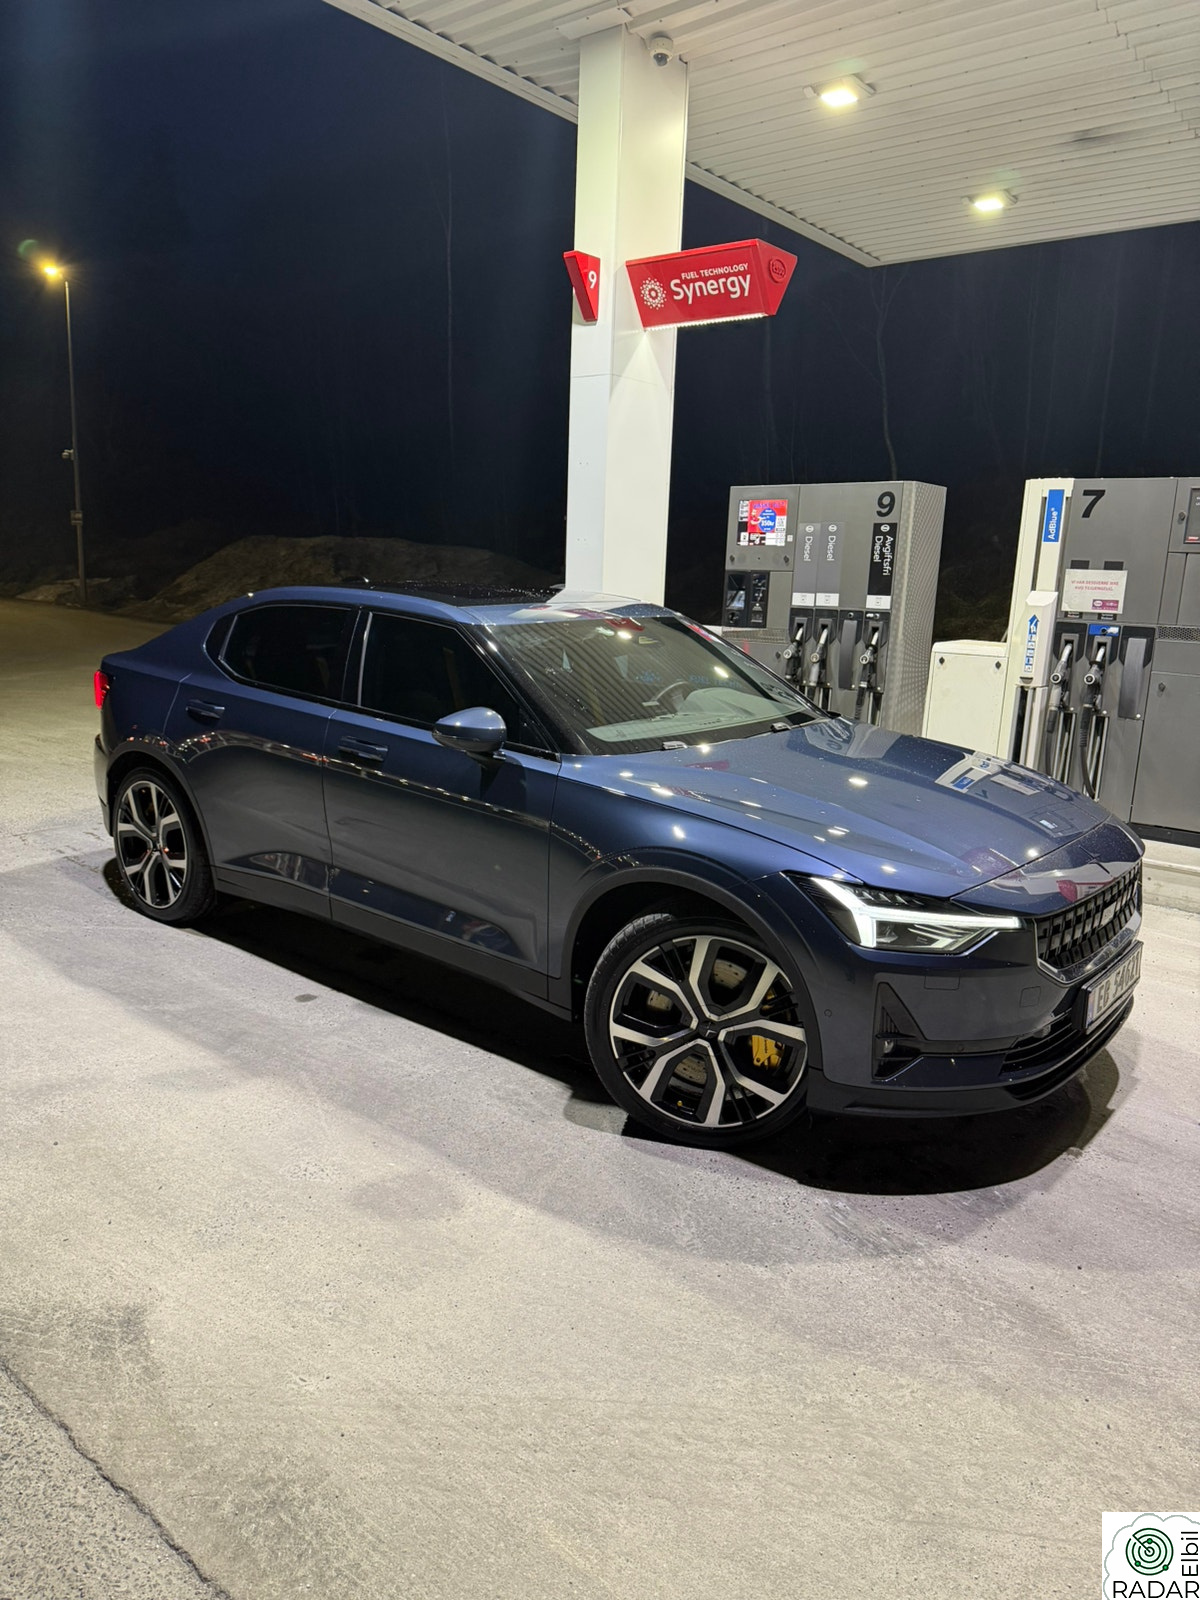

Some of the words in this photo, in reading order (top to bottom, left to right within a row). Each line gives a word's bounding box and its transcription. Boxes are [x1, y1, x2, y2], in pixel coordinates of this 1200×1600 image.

[588, 270, 598, 289] 9
[681, 271, 699, 280] FUEL
[699, 262, 749, 277] TECHNOLOGY
[670, 274, 751, 305] Synergy
[876, 491, 896, 517] 9
[1081, 489, 1106, 518] 7
[803, 536, 814, 562] Diesel
[826, 535, 837, 561] Diesel
[873, 535, 884, 562] Diesel
[882, 535, 894, 576] Avgiftsfri
